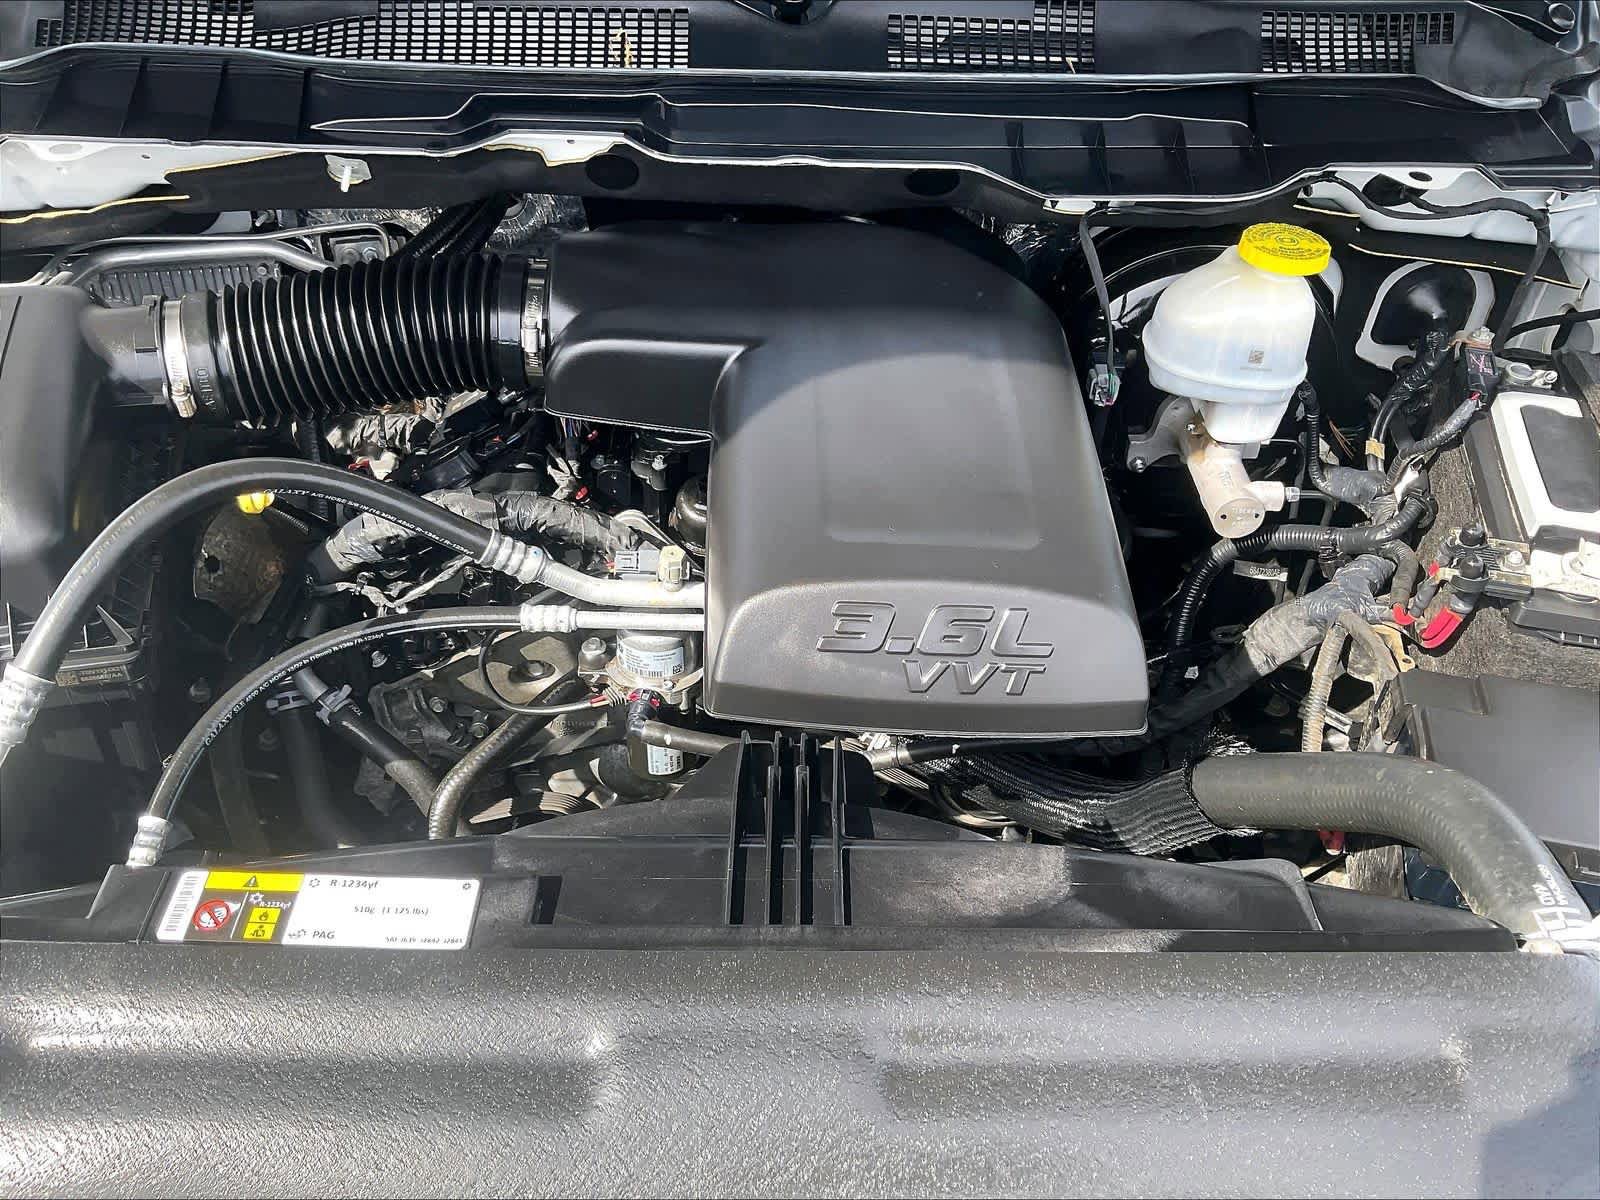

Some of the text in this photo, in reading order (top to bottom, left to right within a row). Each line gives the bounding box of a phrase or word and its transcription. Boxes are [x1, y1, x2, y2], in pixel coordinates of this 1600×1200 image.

[324, 494, 347, 504] HOSE
[816, 600, 1056, 659] 3.6L
[902, 658, 1048, 697] VVT
[205, 711, 233, 746] GALAXY
[259, 901, 292, 911] R-1234yf
[312, 930, 336, 940] PAG
